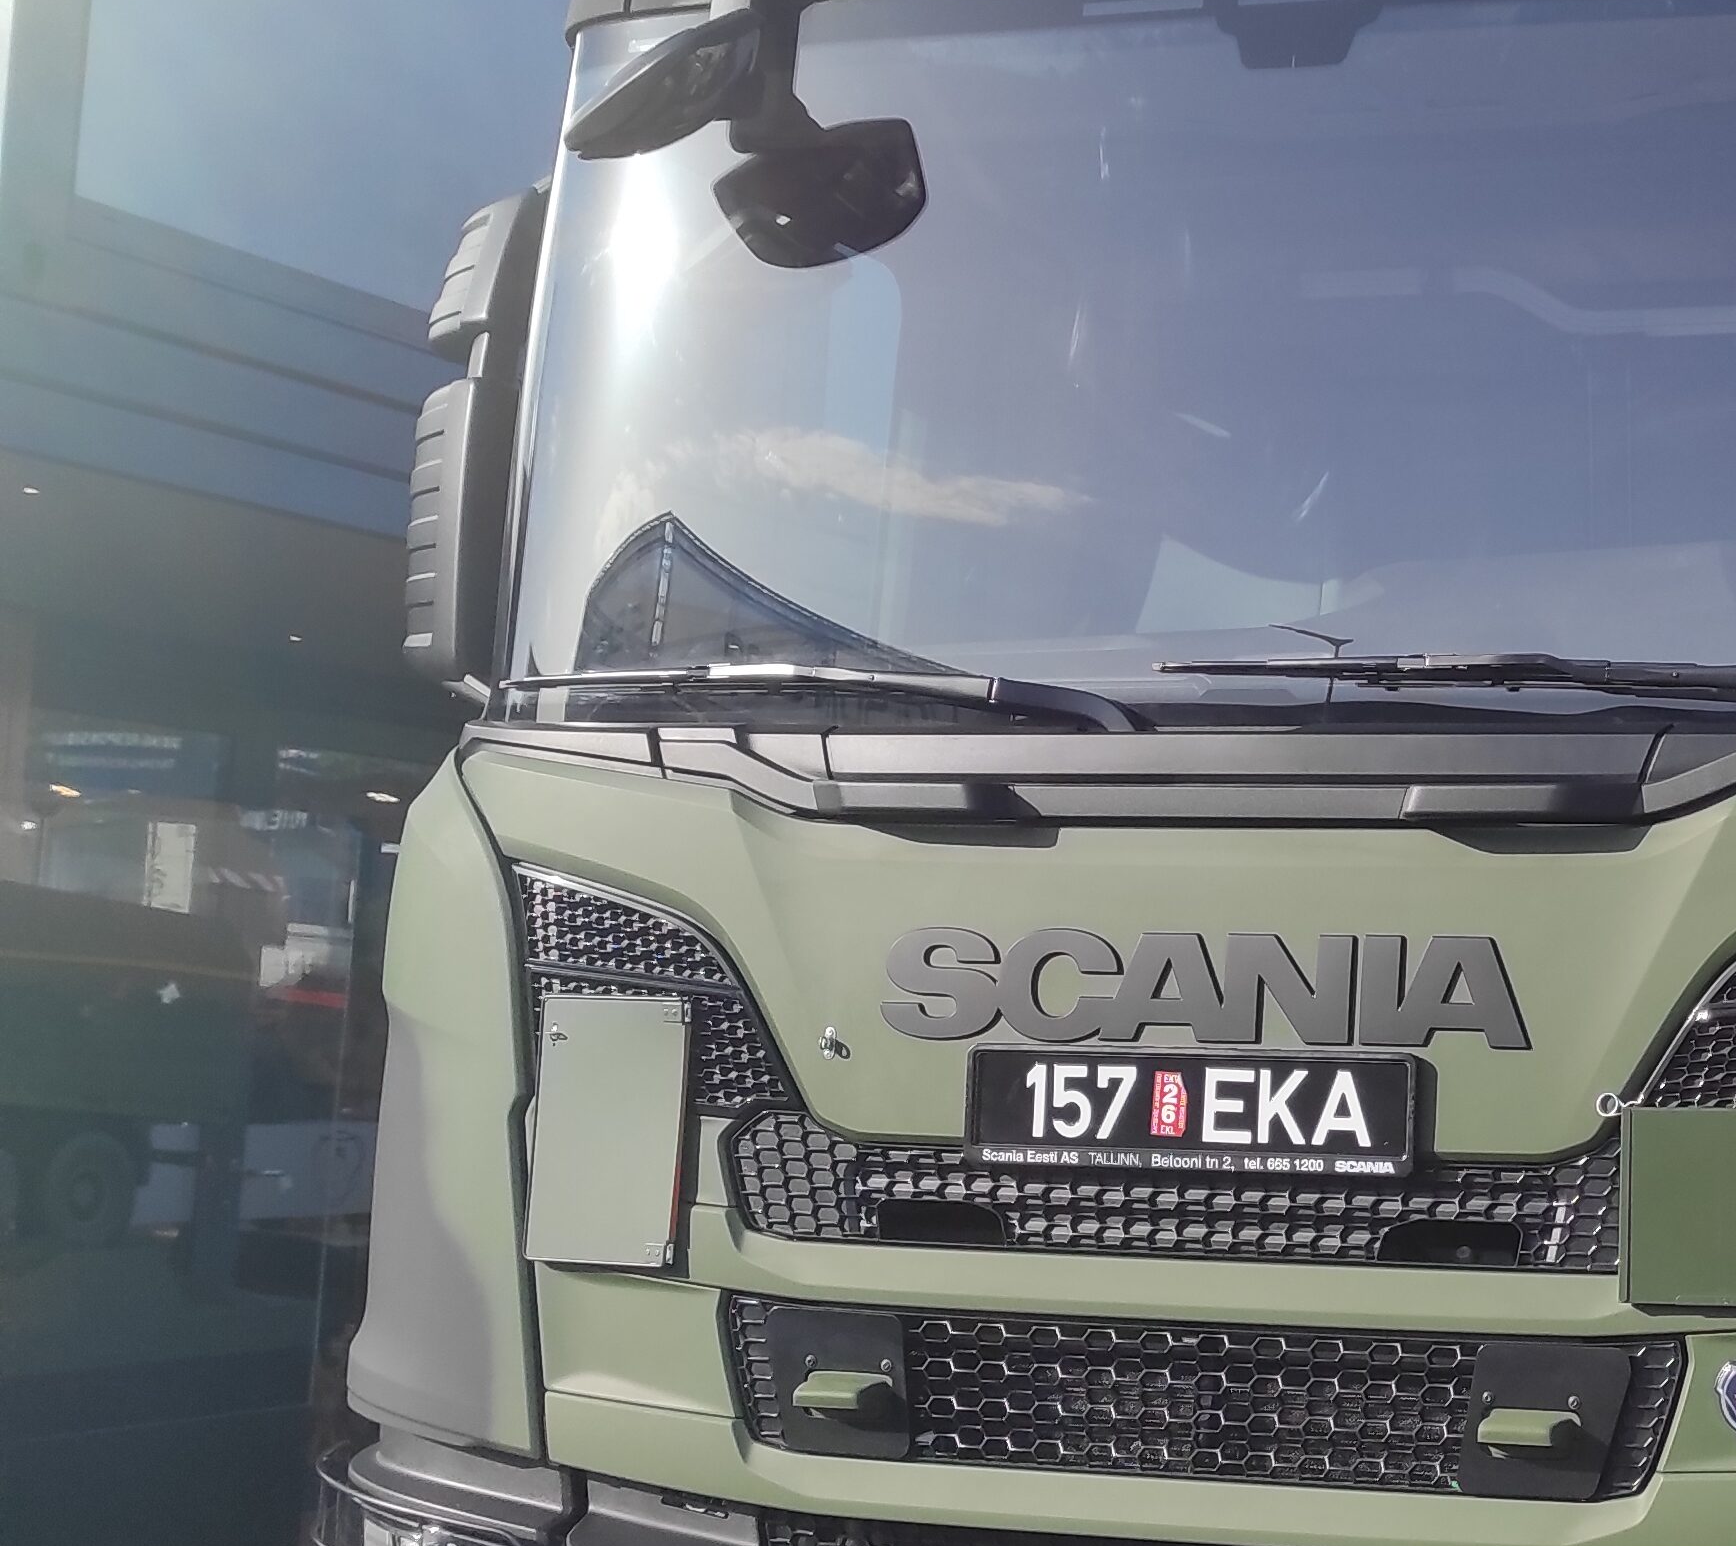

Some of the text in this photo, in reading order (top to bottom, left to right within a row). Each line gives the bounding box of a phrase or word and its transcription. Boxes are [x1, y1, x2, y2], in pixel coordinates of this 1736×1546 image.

[879, 926, 1533, 1051] SCANIA
[1026, 1062, 1137, 1140] 157
[1201, 1066, 1373, 1147] EKA
[981, 1148, 1024, 1163] Scania
[1026, 1150, 1058, 1164] Eesti
[1060, 1151, 1079, 1164] AS
[1088, 1151, 1143, 1168] TALLINN,
[1222, 1156, 1235, 1173] 2,
[1244, 1157, 1264, 1170] tel.
[1267, 1157, 1290, 1171] 665
[1293, 1158, 1324, 1172] 1200
[1334, 1160, 1396, 1174] SCANIA
